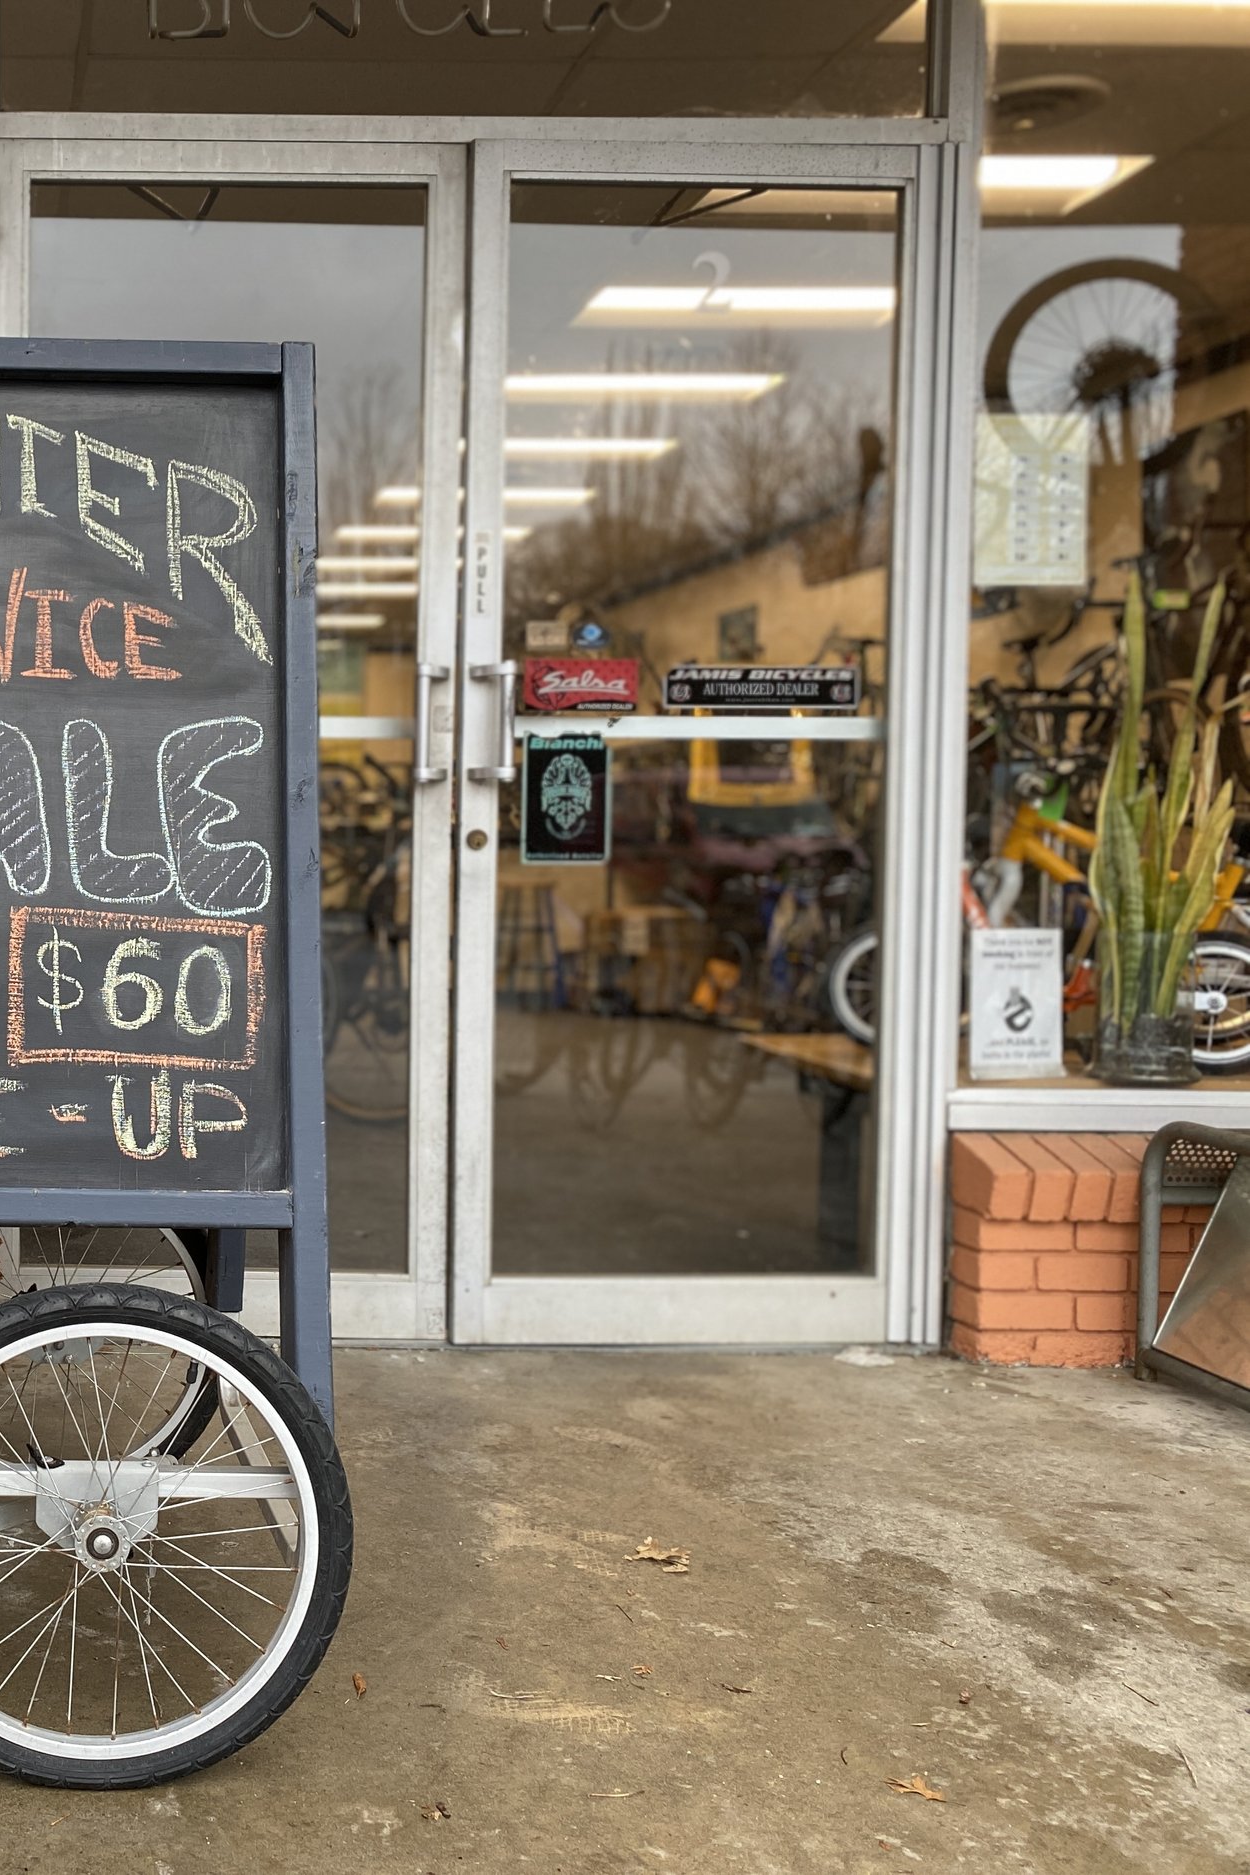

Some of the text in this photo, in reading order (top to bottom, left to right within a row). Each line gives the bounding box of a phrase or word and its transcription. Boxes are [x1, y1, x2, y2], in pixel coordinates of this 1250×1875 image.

[692, 251, 732, 314] 2
[476, 546, 488, 614] PULL
[538, 669, 631, 696] Salsa
[669, 669, 854, 681] JAMIS BICYCLES
[703, 682, 820, 696] AUTHORIZED DEALER
[576, 703, 634, 711] AUTHORIZED DEALER
[530, 736, 604, 750] Bianchi
[36, 925, 233, 1036] $60
